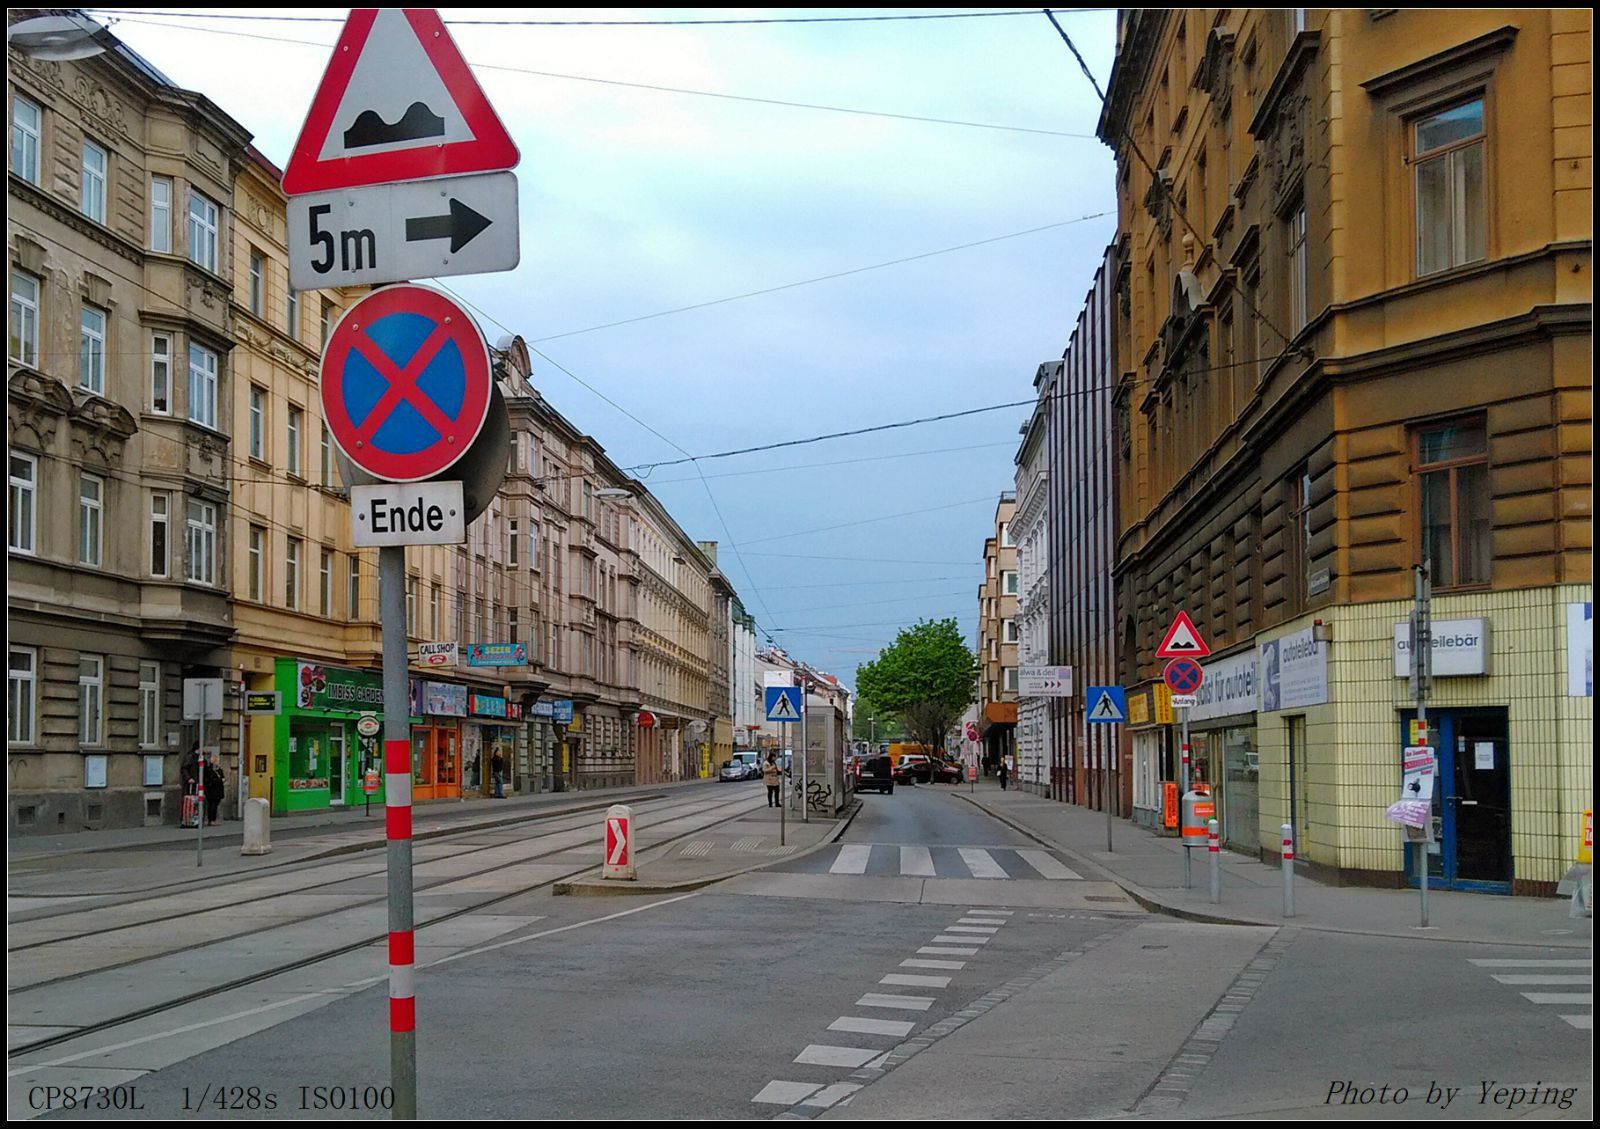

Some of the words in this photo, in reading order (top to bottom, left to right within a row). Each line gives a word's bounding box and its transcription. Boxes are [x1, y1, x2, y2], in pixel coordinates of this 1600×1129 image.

[309, 204, 377, 275] 5m
[370, 497, 444, 534] Ende
[420, 644, 436, 655] CALL
[437, 643, 455, 654] SHOP
[328, 682, 355, 701] IMBISS
